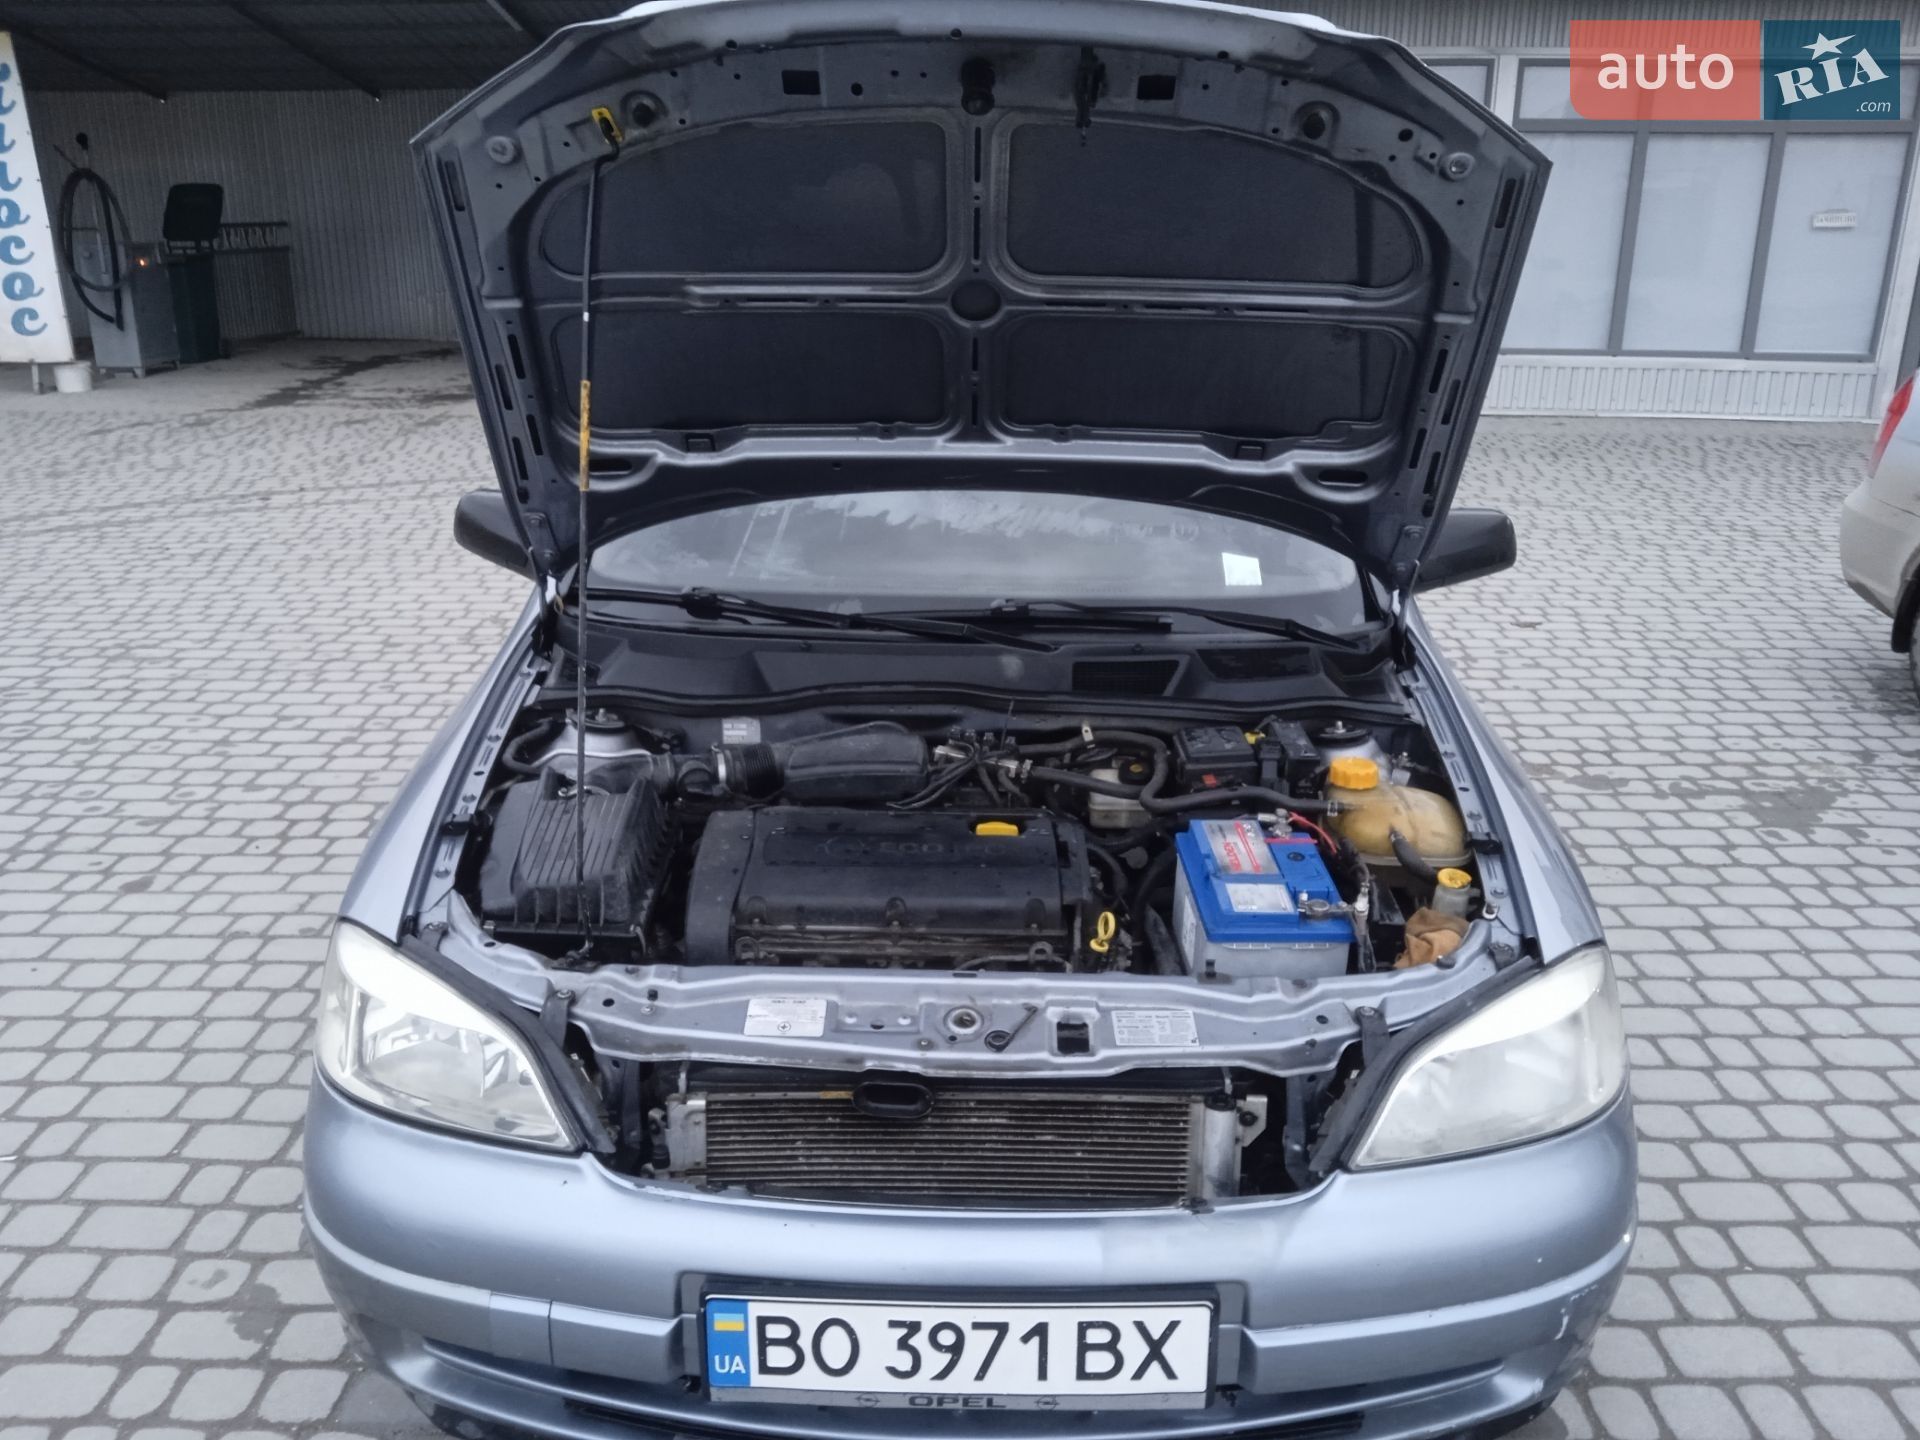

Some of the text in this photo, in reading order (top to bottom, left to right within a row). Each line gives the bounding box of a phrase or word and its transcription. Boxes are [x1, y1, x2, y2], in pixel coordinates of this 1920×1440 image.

[756, 1315, 1181, 1381] BO 3971 BX
[714, 1355, 746, 1374] UA
[908, 1395, 1007, 1409] OPEL
